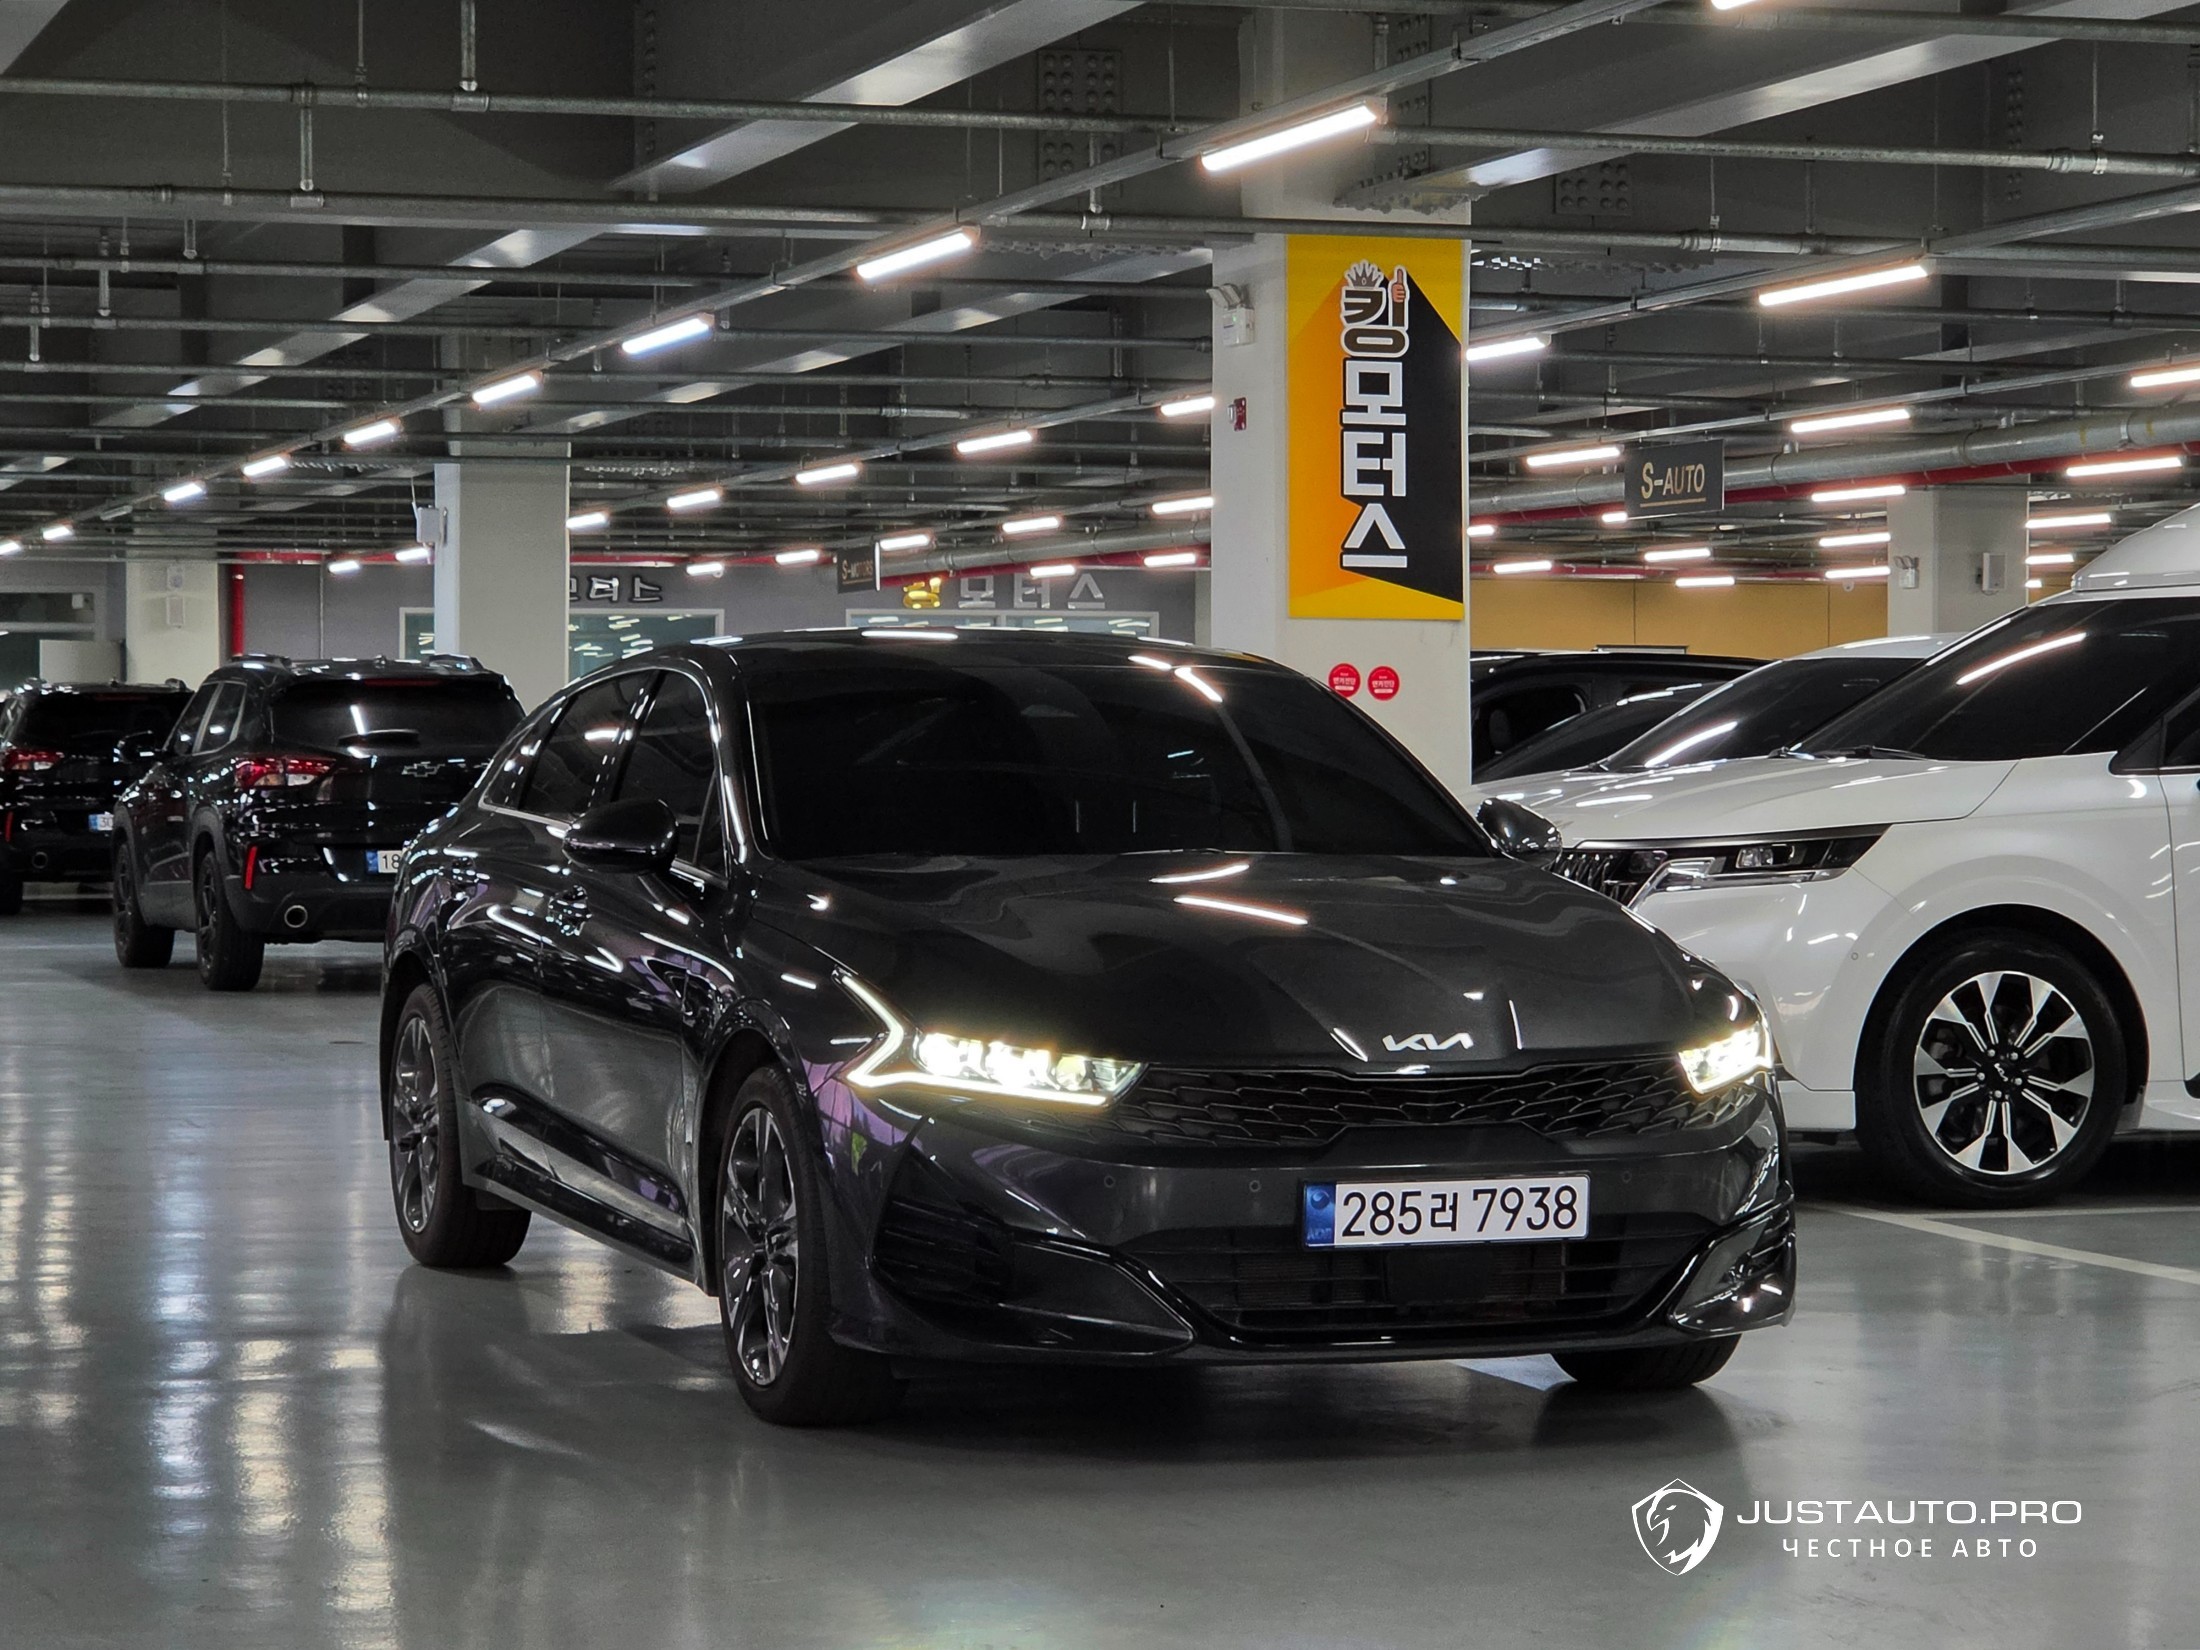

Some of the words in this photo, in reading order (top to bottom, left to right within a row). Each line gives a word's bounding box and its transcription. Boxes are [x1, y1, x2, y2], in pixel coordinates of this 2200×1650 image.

[1341, 264, 1408, 568] 킹모터스
[1641, 462, 1705, 499] S-AUTO
[1382, 1032, 1474, 1051] KIA
[1342, 1191, 1458, 1237] 285러
[1472, 1185, 1578, 1233] 7938
